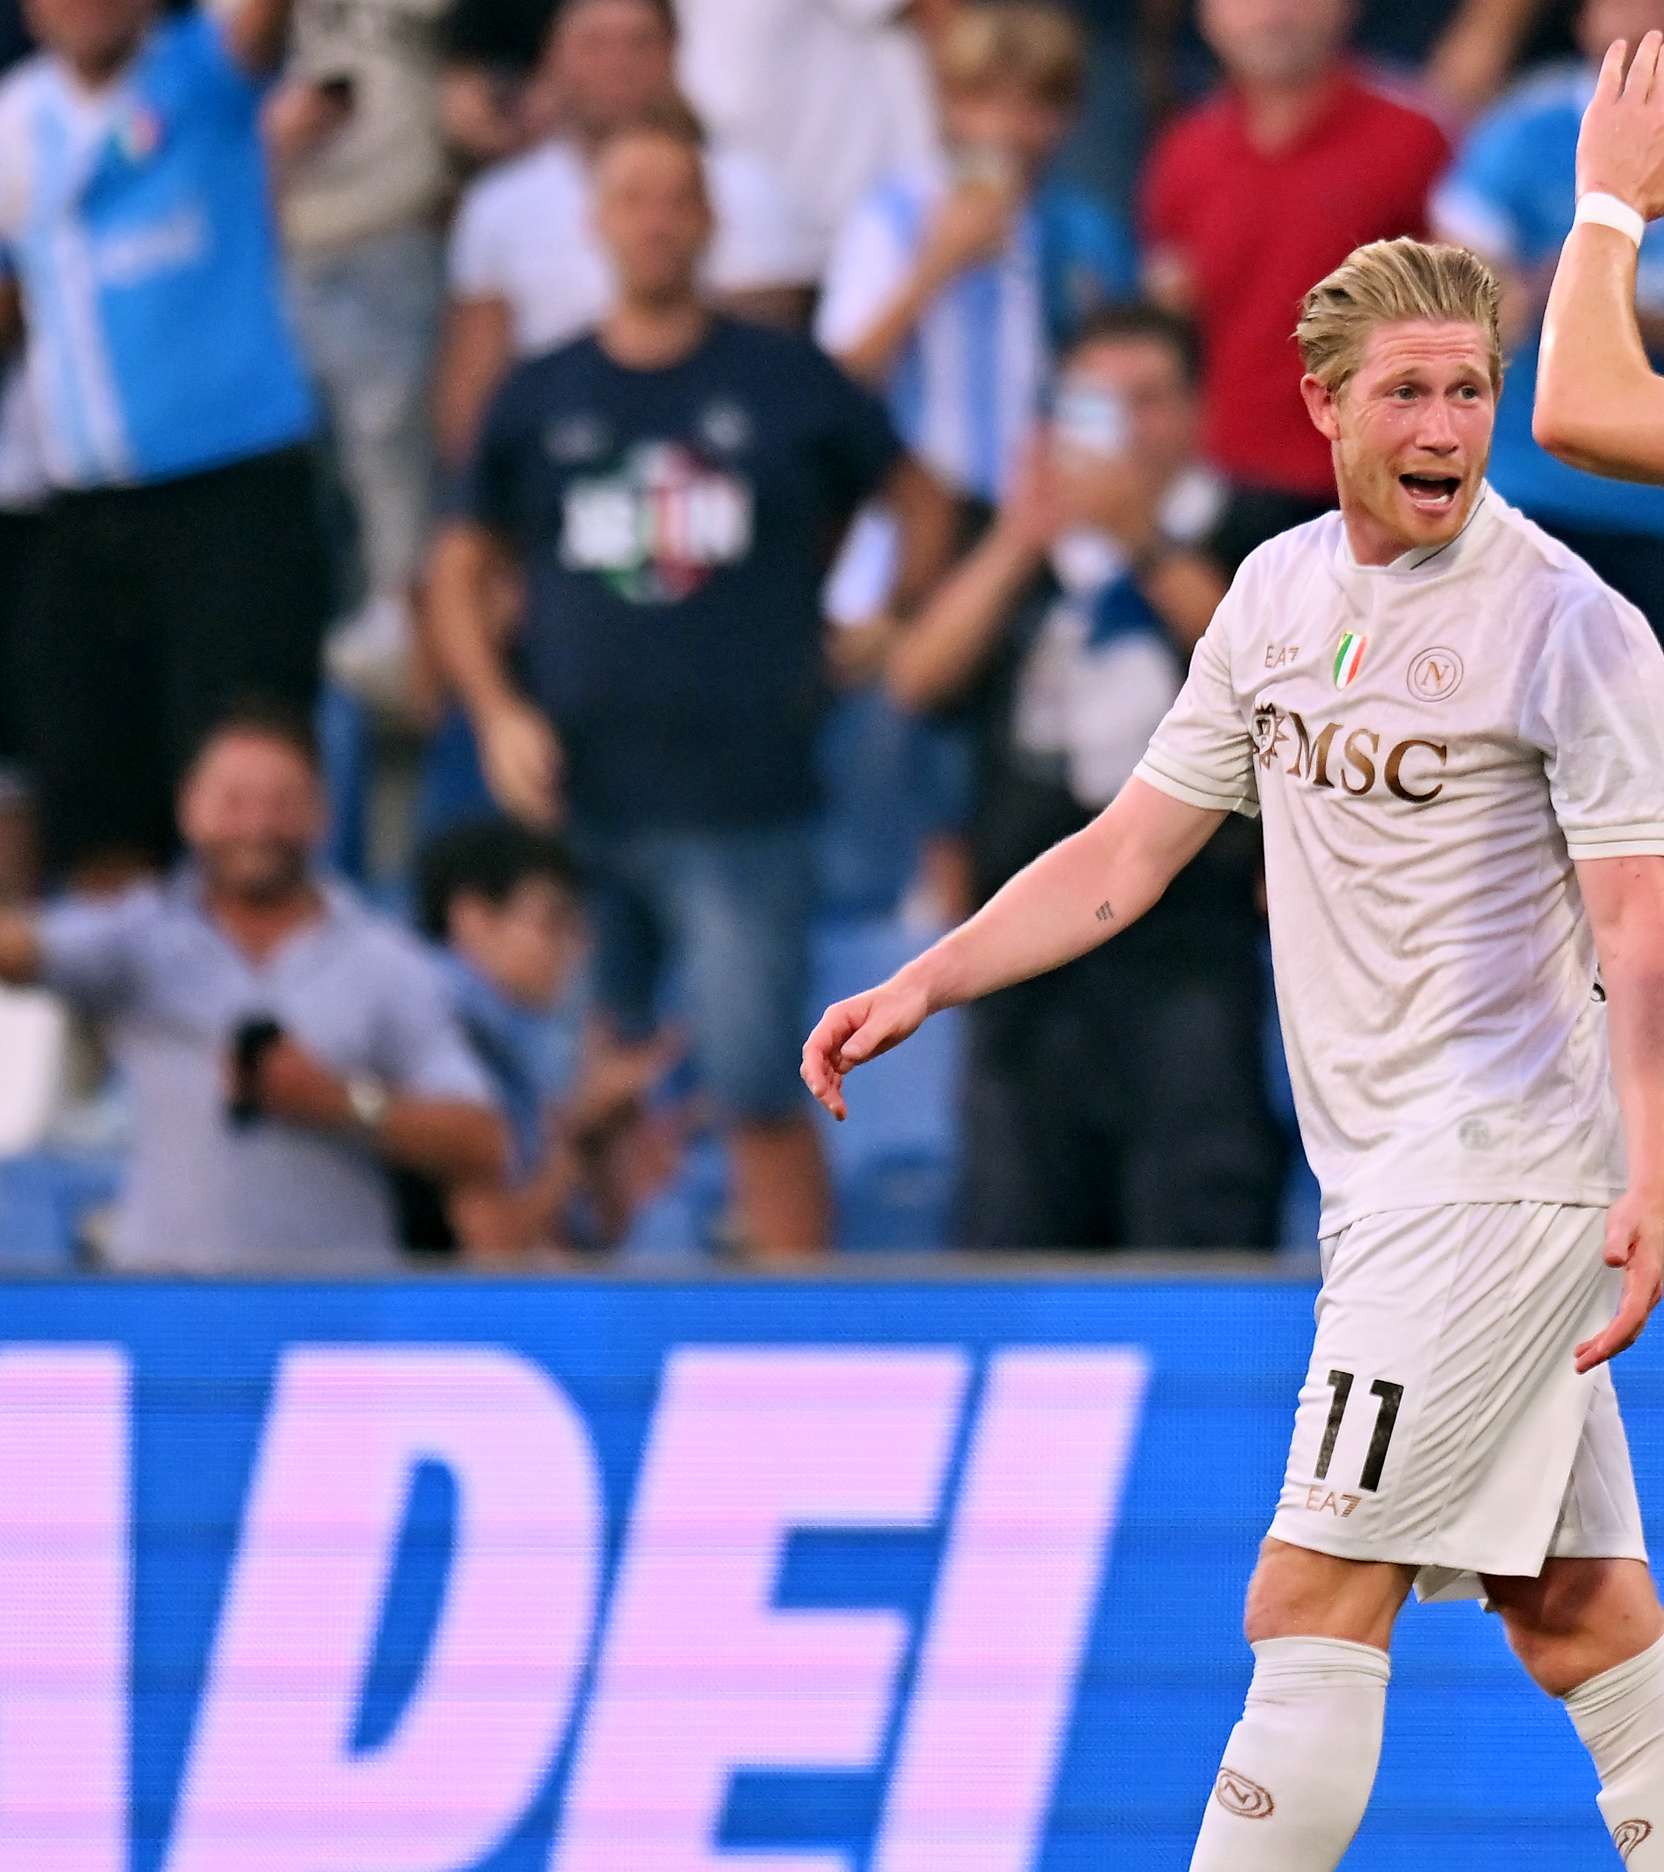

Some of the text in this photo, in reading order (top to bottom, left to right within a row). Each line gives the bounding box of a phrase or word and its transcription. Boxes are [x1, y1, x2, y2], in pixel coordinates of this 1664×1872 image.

[1264, 645, 1300, 669] EA7
[1286, 711, 1448, 803] MSC
[1314, 1369, 1405, 1493] 11
[1306, 1485, 1362, 1518] EA7
